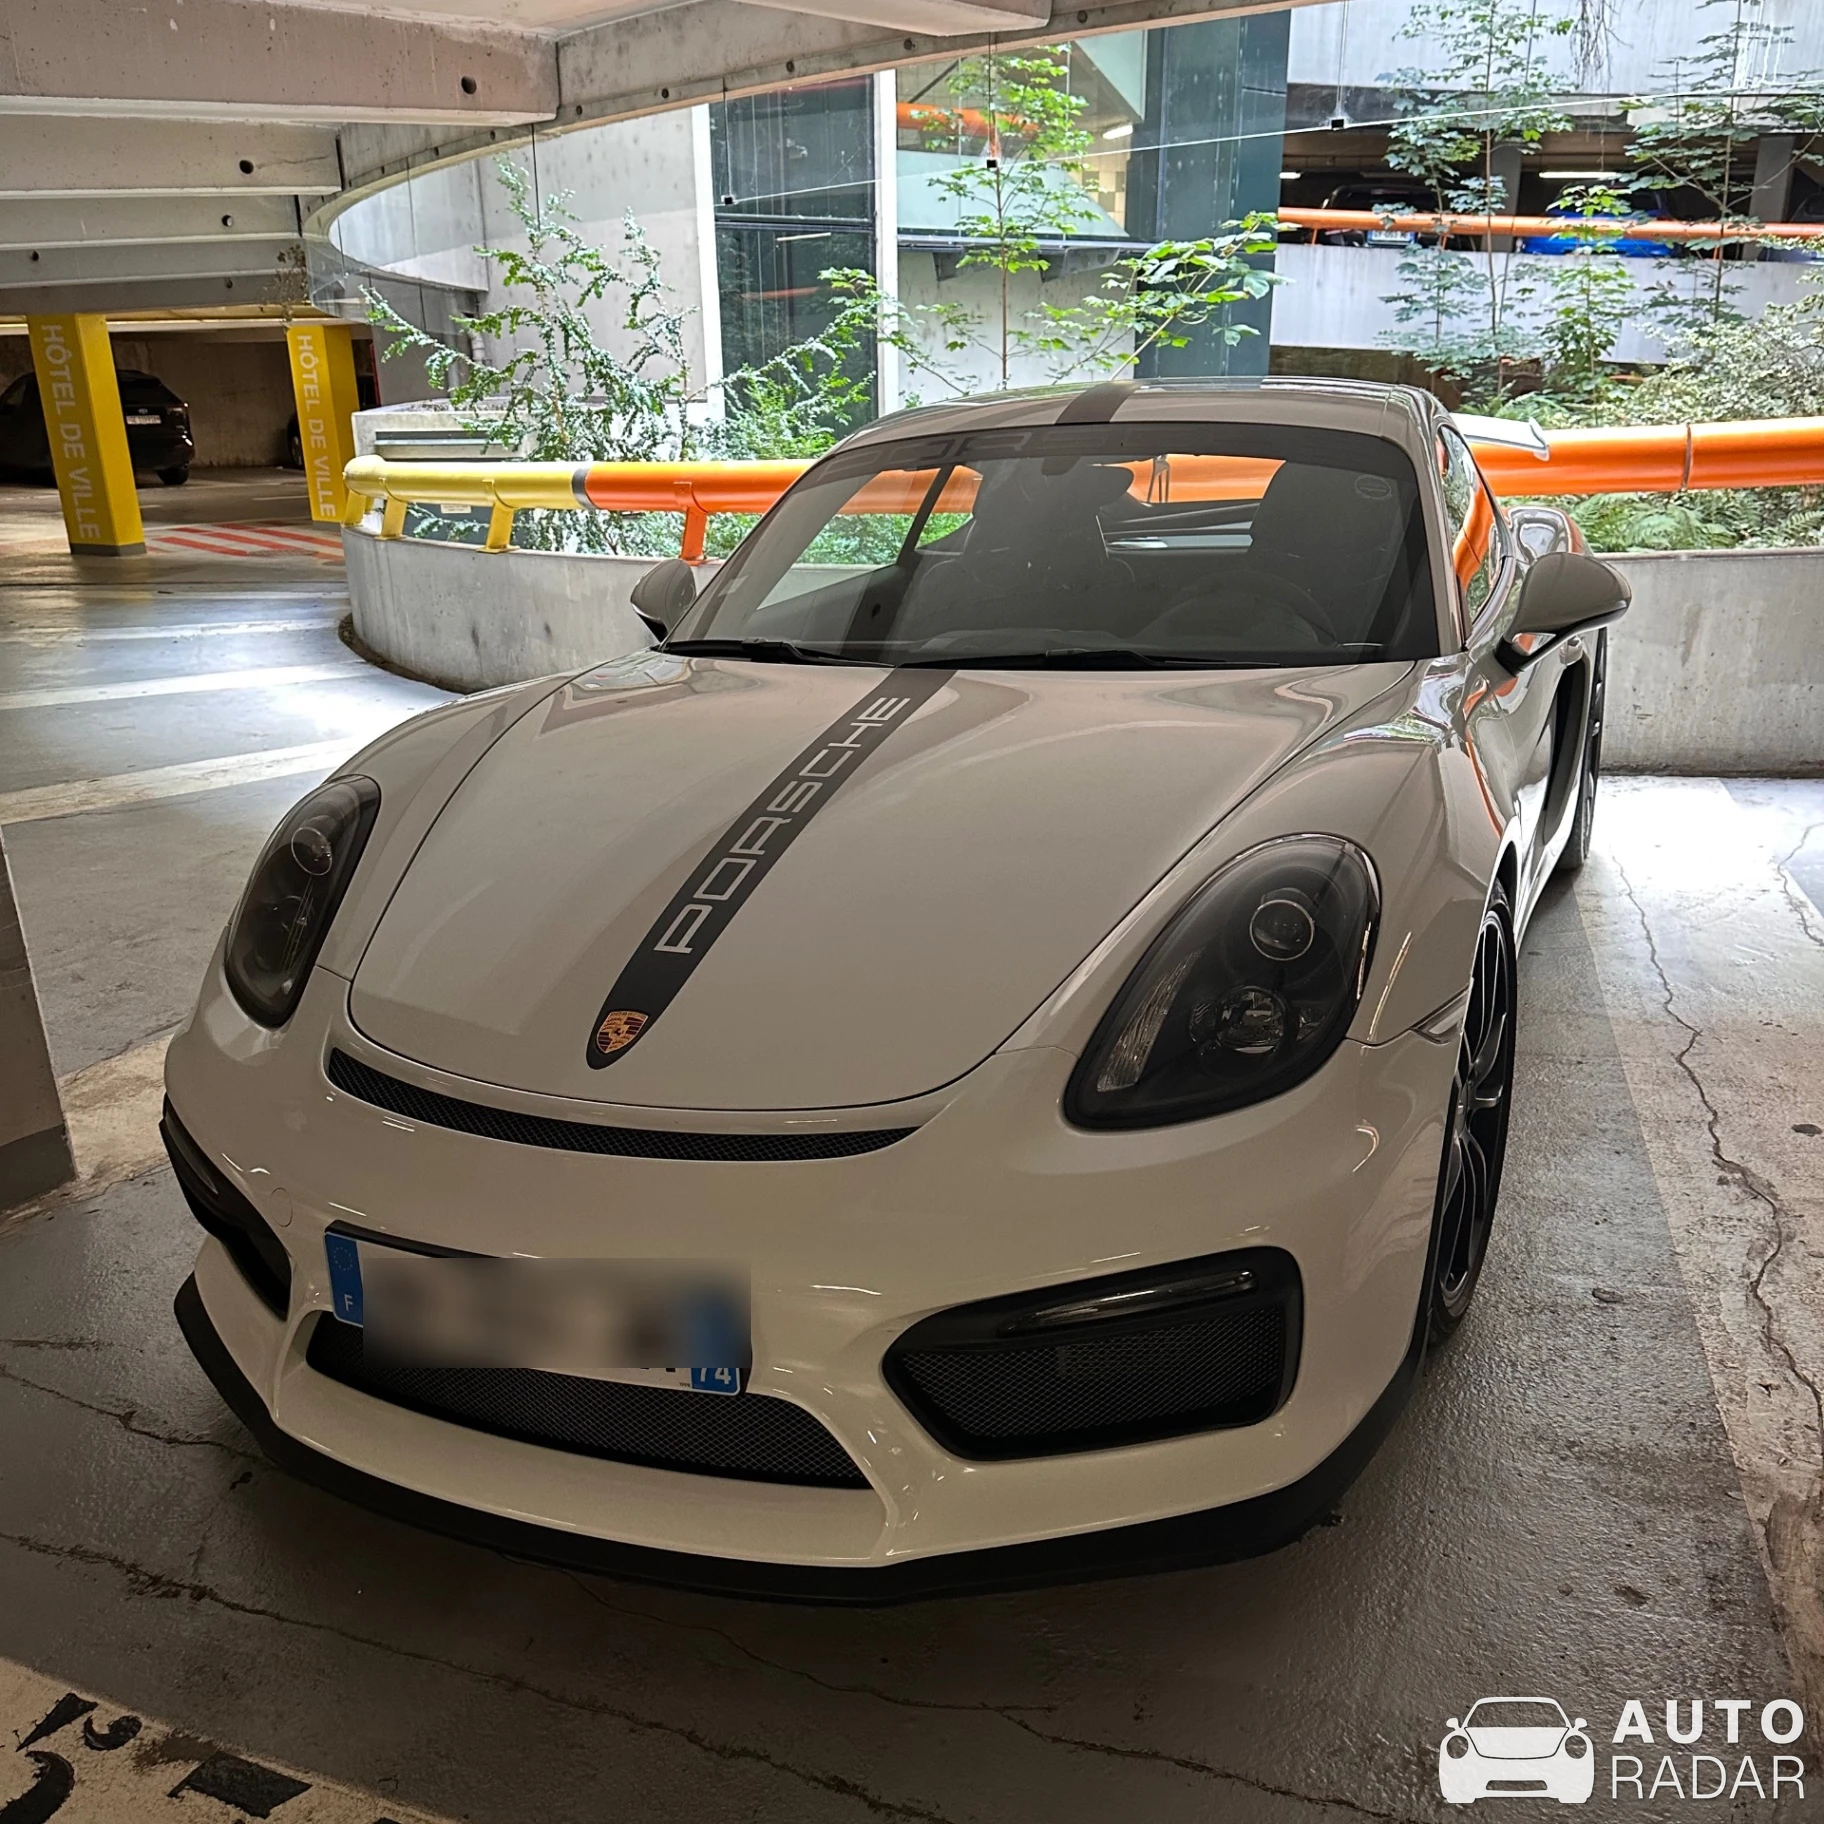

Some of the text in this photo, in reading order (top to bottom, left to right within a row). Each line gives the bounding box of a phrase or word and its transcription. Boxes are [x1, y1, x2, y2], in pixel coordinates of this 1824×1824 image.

[41, 324, 100, 539] HÔTEL DE VILLE
[297, 335, 336, 518] HÔTEL DE VILLE
[653, 697, 911, 954] PORSCHE
[344, 1293, 353, 1311] F
